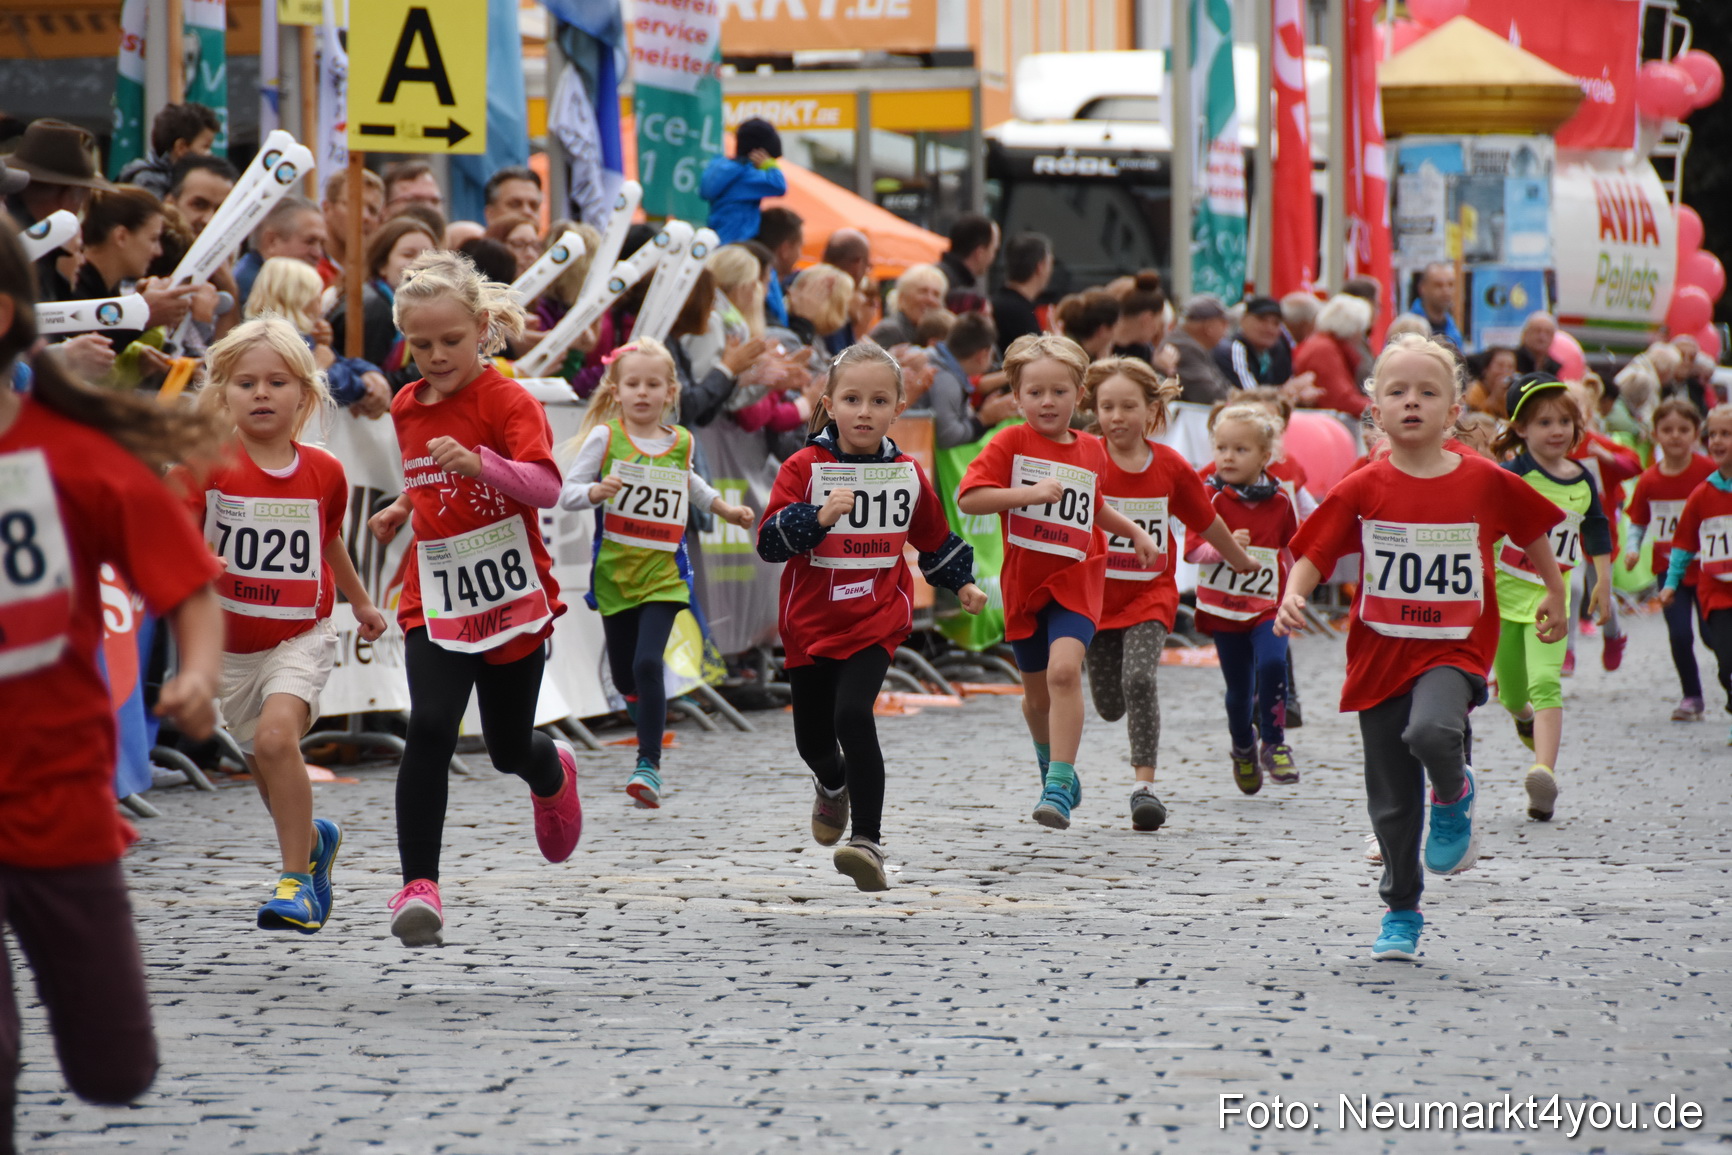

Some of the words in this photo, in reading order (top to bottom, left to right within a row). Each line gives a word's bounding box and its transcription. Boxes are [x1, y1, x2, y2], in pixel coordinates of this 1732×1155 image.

[377, 6, 456, 106] A
[1592, 176, 1660, 246] AVIA
[1591, 252, 1659, 311] Pellets
[864, 466, 910, 480] BOCK
[1056, 466, 1092, 485] BOCK
[254, 503, 310, 518] BOCK
[618, 482, 682, 519] 7257
[823, 488, 911, 528] 013
[1125, 501, 1163, 512] BOCK
[454, 522, 516, 555] BOCK
[1033, 524, 1069, 543] Paula
[1372, 533, 1408, 544] NeuerMarkt
[1416, 528, 1473, 542] BOCK
[216, 520, 310, 574] 7029
[843, 538, 890, 557] Sophia
[433, 548, 528, 612] 7408
[1375, 549, 1473, 595] 7045
[234, 580, 280, 606] Emily
[844, 585, 866, 596] DEHN
[456, 605, 513, 643] ANNE
[1401, 604, 1442, 623] Frida
